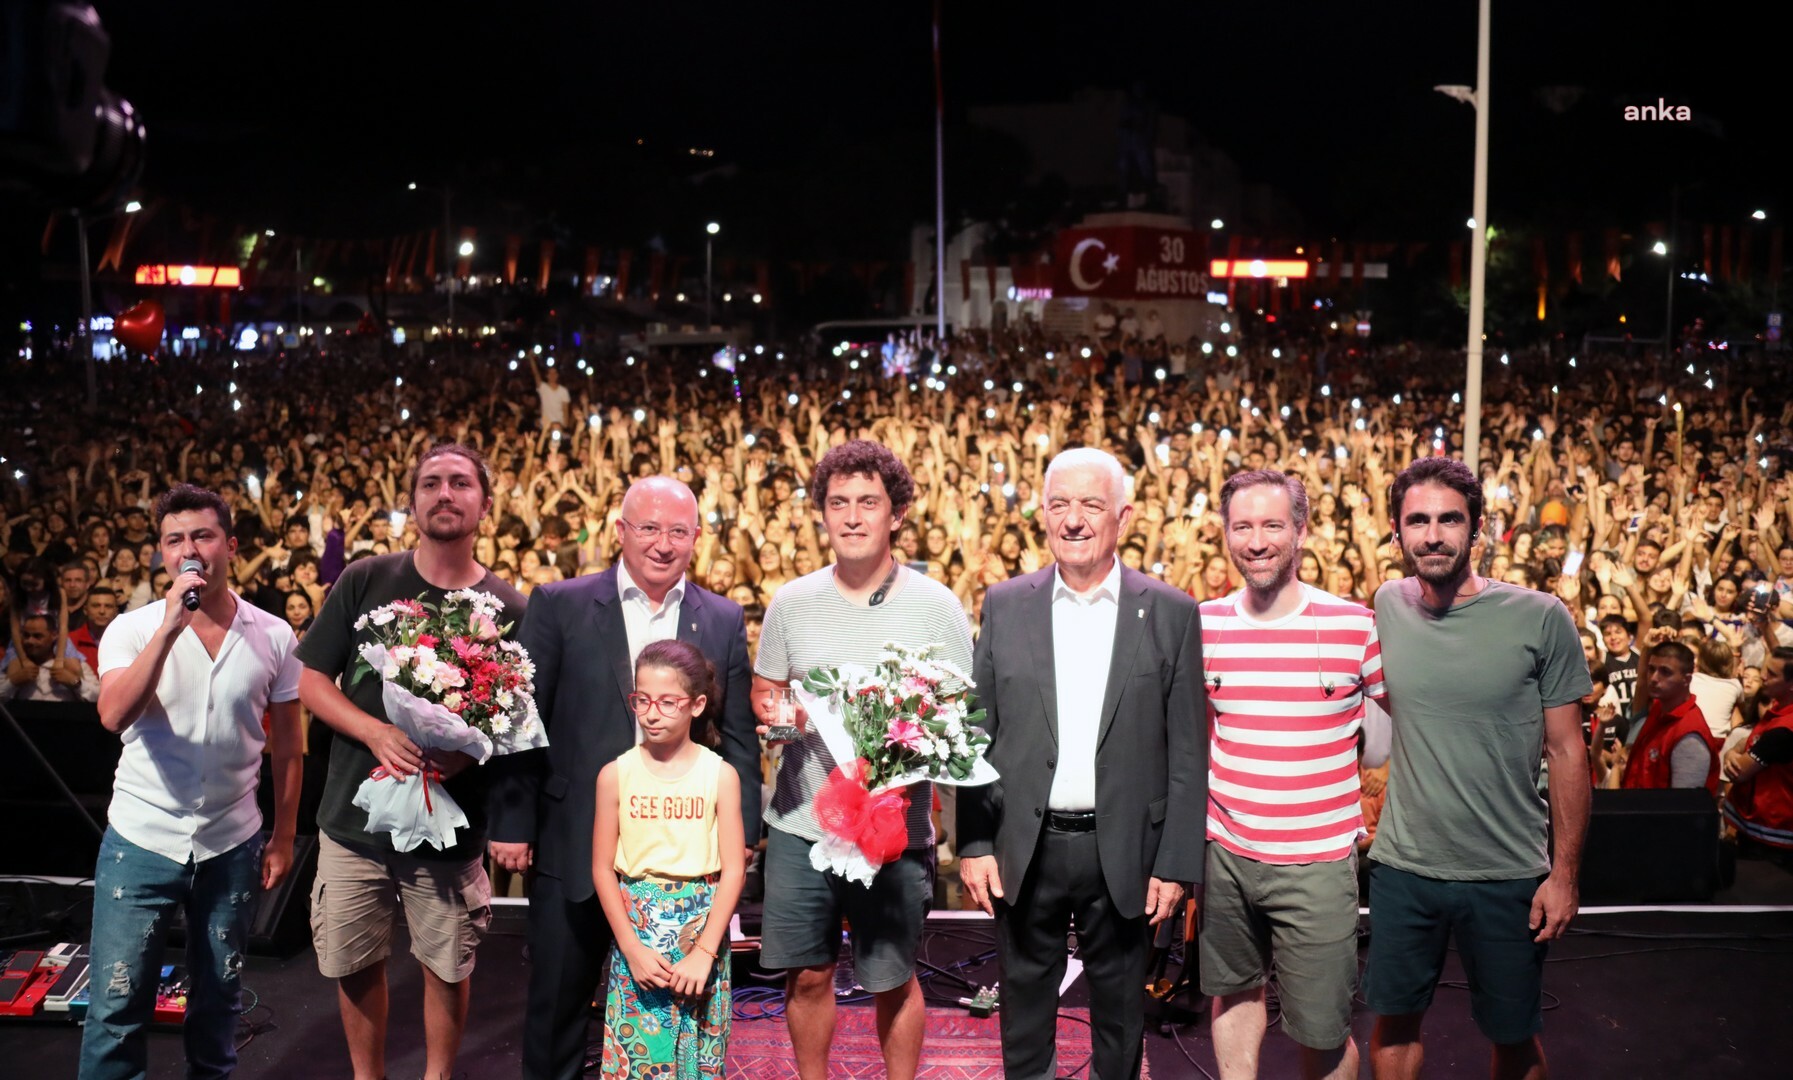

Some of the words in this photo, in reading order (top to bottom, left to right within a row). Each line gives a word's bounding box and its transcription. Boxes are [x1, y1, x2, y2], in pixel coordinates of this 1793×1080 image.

[1160, 235, 1185, 264] 30
[1136, 264, 1209, 295] AĞUSTOS
[630, 795, 659, 819] SEE
[663, 795, 704, 820] GOOD
